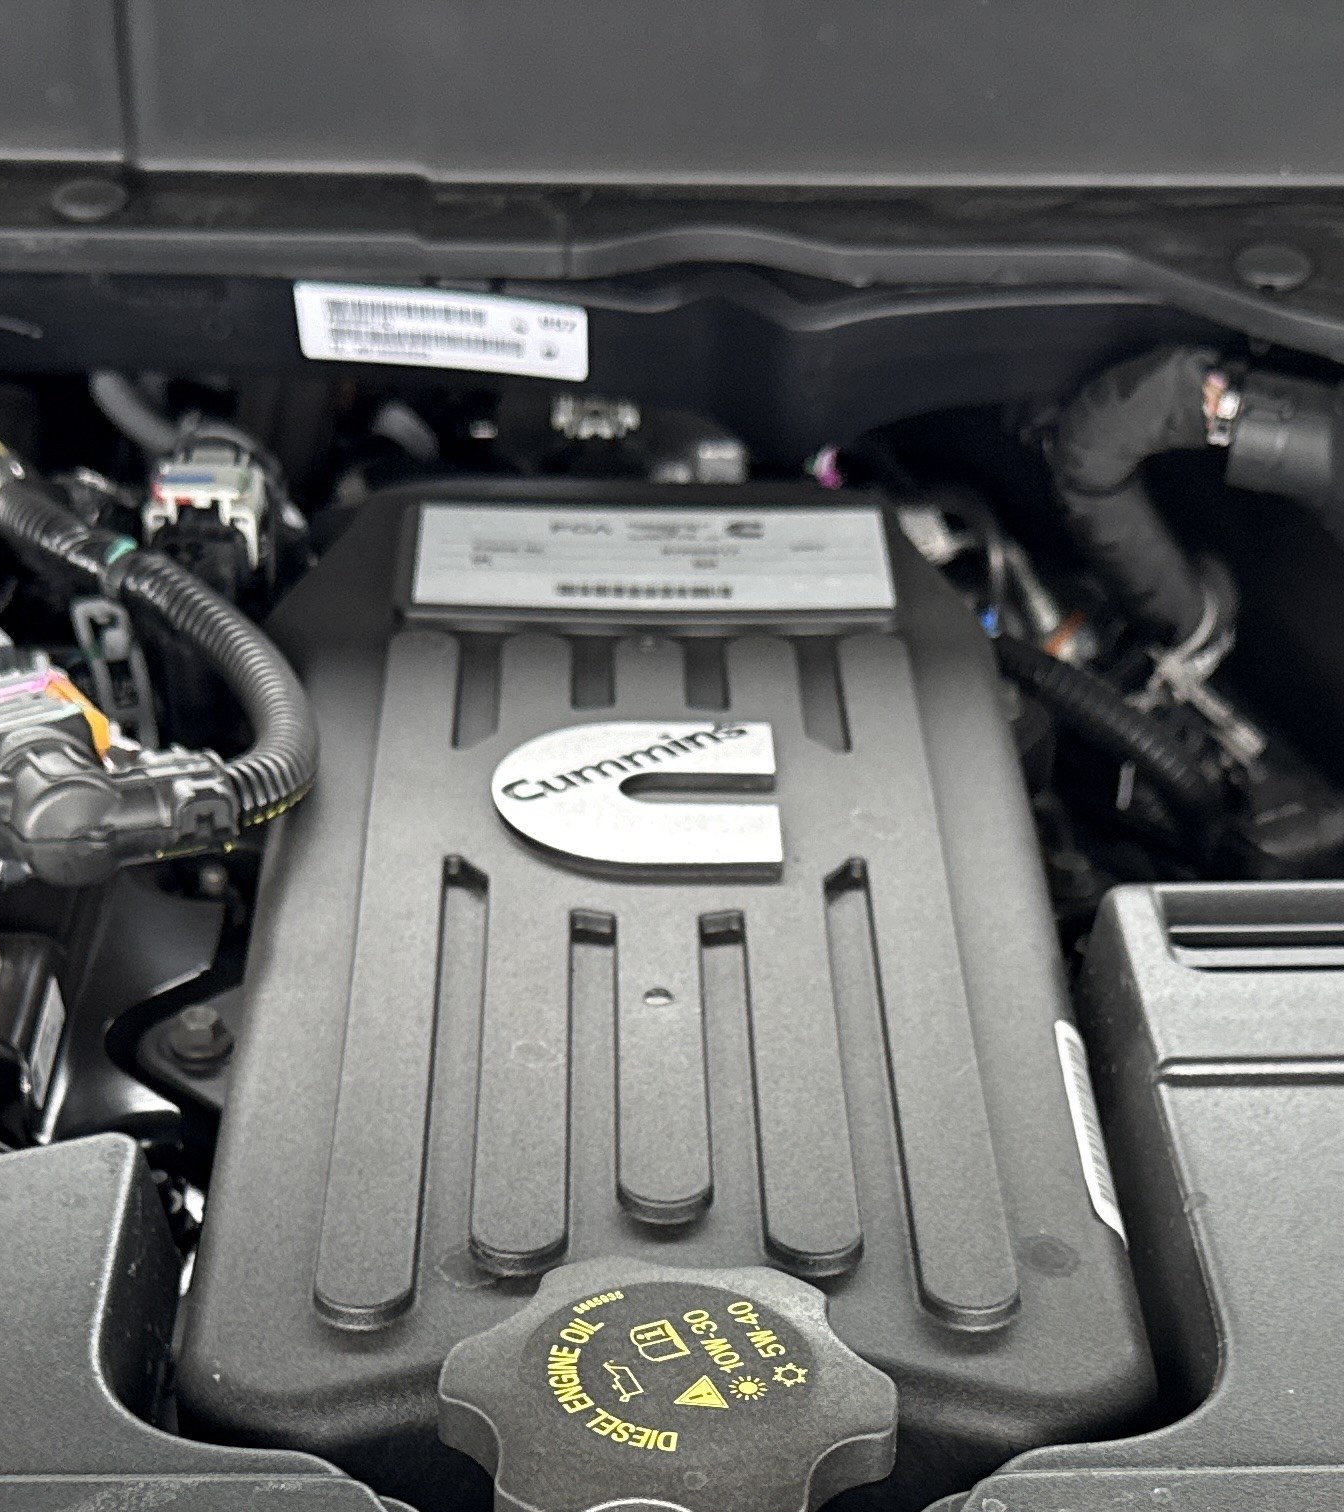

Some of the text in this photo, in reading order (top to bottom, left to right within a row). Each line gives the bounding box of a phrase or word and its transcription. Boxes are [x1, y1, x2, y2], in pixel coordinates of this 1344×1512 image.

[502, 722, 748, 802] Cummins
[683, 1309, 744, 1373] 10W-30
[727, 1301, 786, 1358] 5W-40
[547, 1317, 678, 1452] DIESEL ENGINE OIL
